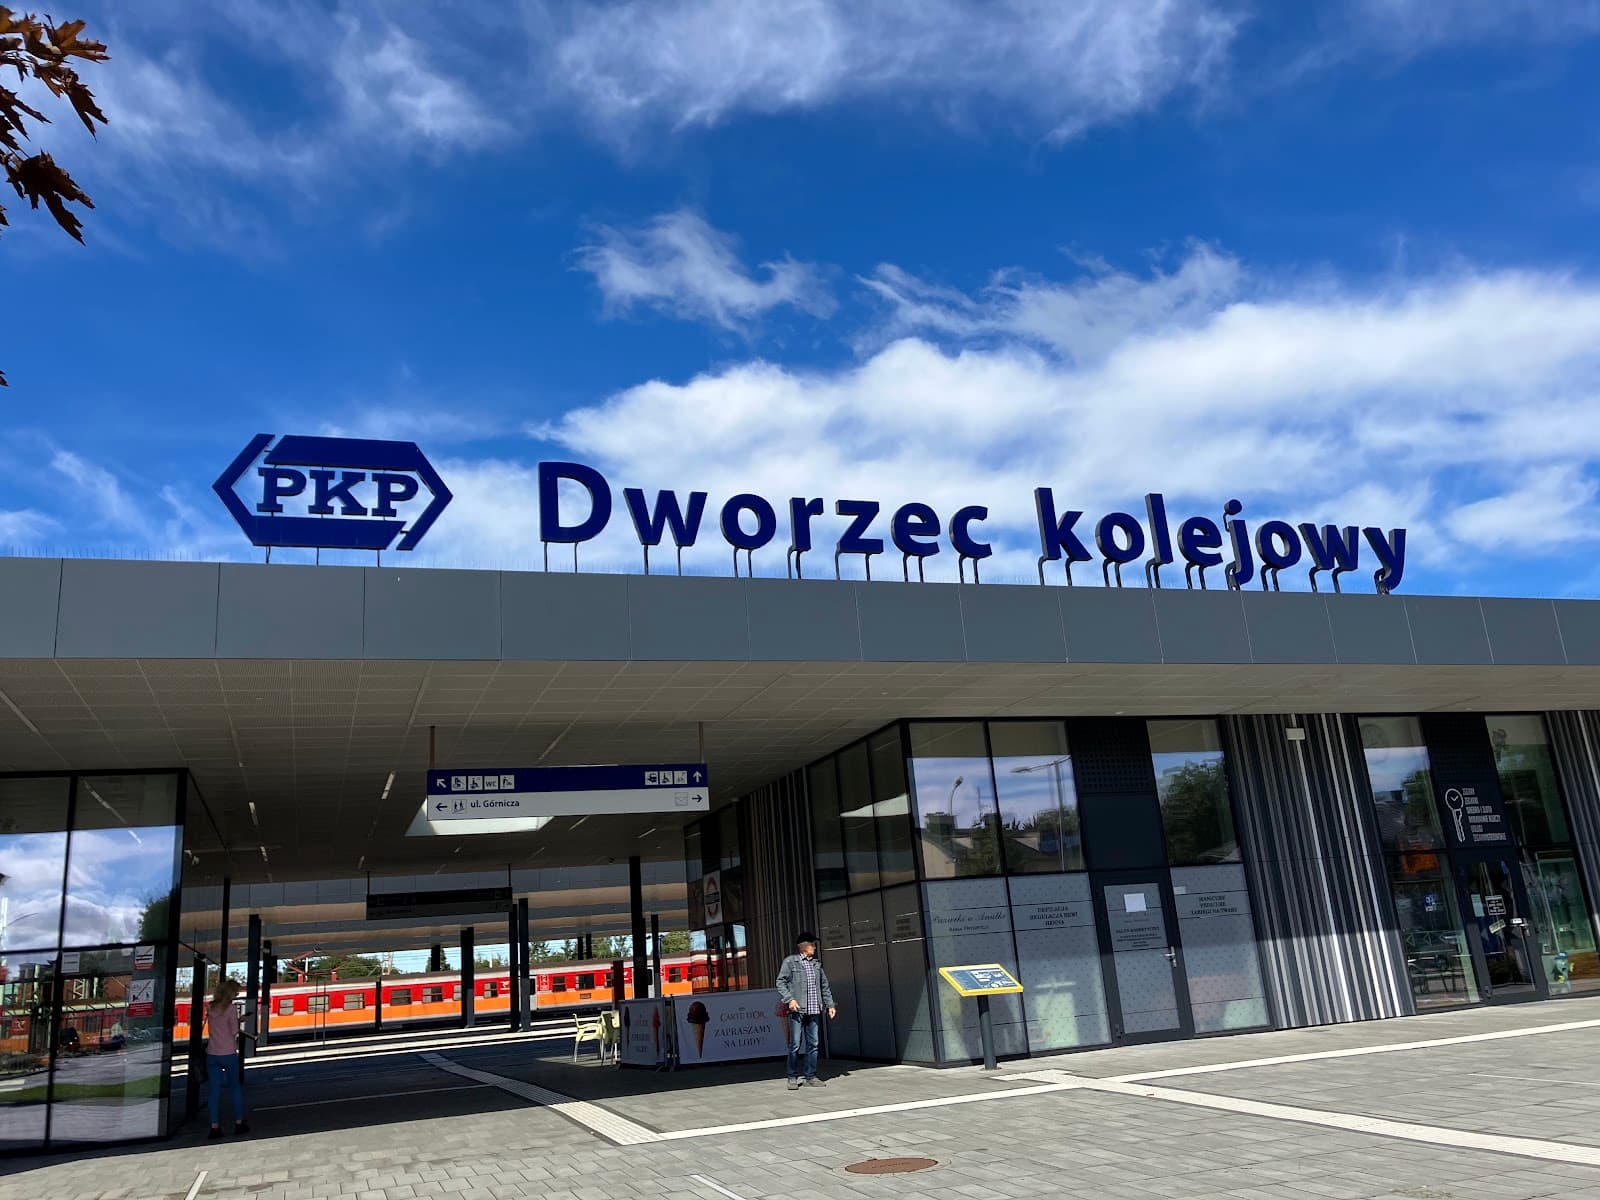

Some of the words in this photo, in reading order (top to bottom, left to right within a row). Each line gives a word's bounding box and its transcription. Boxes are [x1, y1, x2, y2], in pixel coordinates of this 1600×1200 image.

[256, 466, 419, 518] PKP
[538, 461, 993, 559] Dworzec
[1034, 487, 1407, 591] kolejowy
[470, 800, 480, 808] ul.
[483, 799, 520, 808] Górnicza
[713, 1024, 771, 1038] ZAPRASZAMY
[722, 1040, 736, 1048] NA
